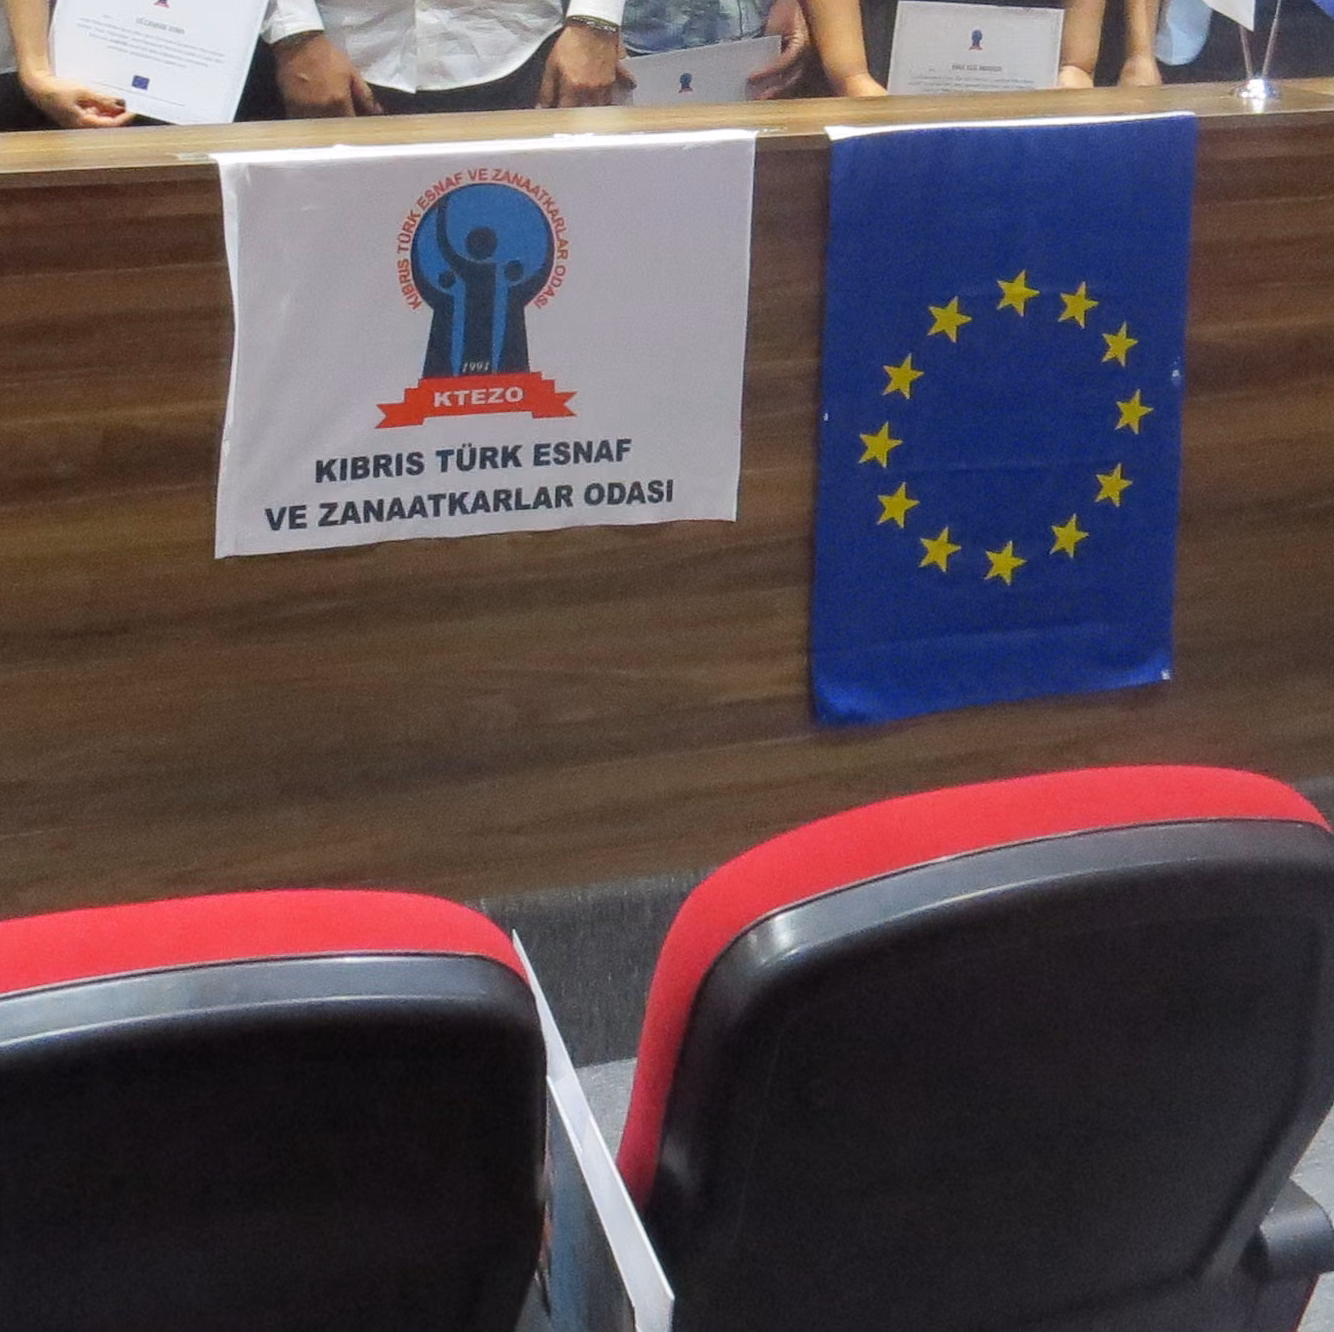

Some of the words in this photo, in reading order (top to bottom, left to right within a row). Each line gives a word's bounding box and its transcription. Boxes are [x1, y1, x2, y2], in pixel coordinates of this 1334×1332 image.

[417, 172, 463, 210] ESNAF
[468, 168, 488, 181] VE
[397, 210, 421, 253] TÜRK
[492, 168, 569, 260] ZANAATKARLAR
[397, 259, 422, 310] KIBRIS
[534, 265, 566, 309] ODASI
[433, 386, 524, 408] KTEZO
[315, 451, 424, 483] KIBRIS
[436, 443, 523, 473] TÜRK
[533, 438, 632, 467] ESNAF
[265, 505, 308, 531] VE
[318, 485, 573, 528] ZANAATKARLAR
[583, 479, 674, 506] ODASI
